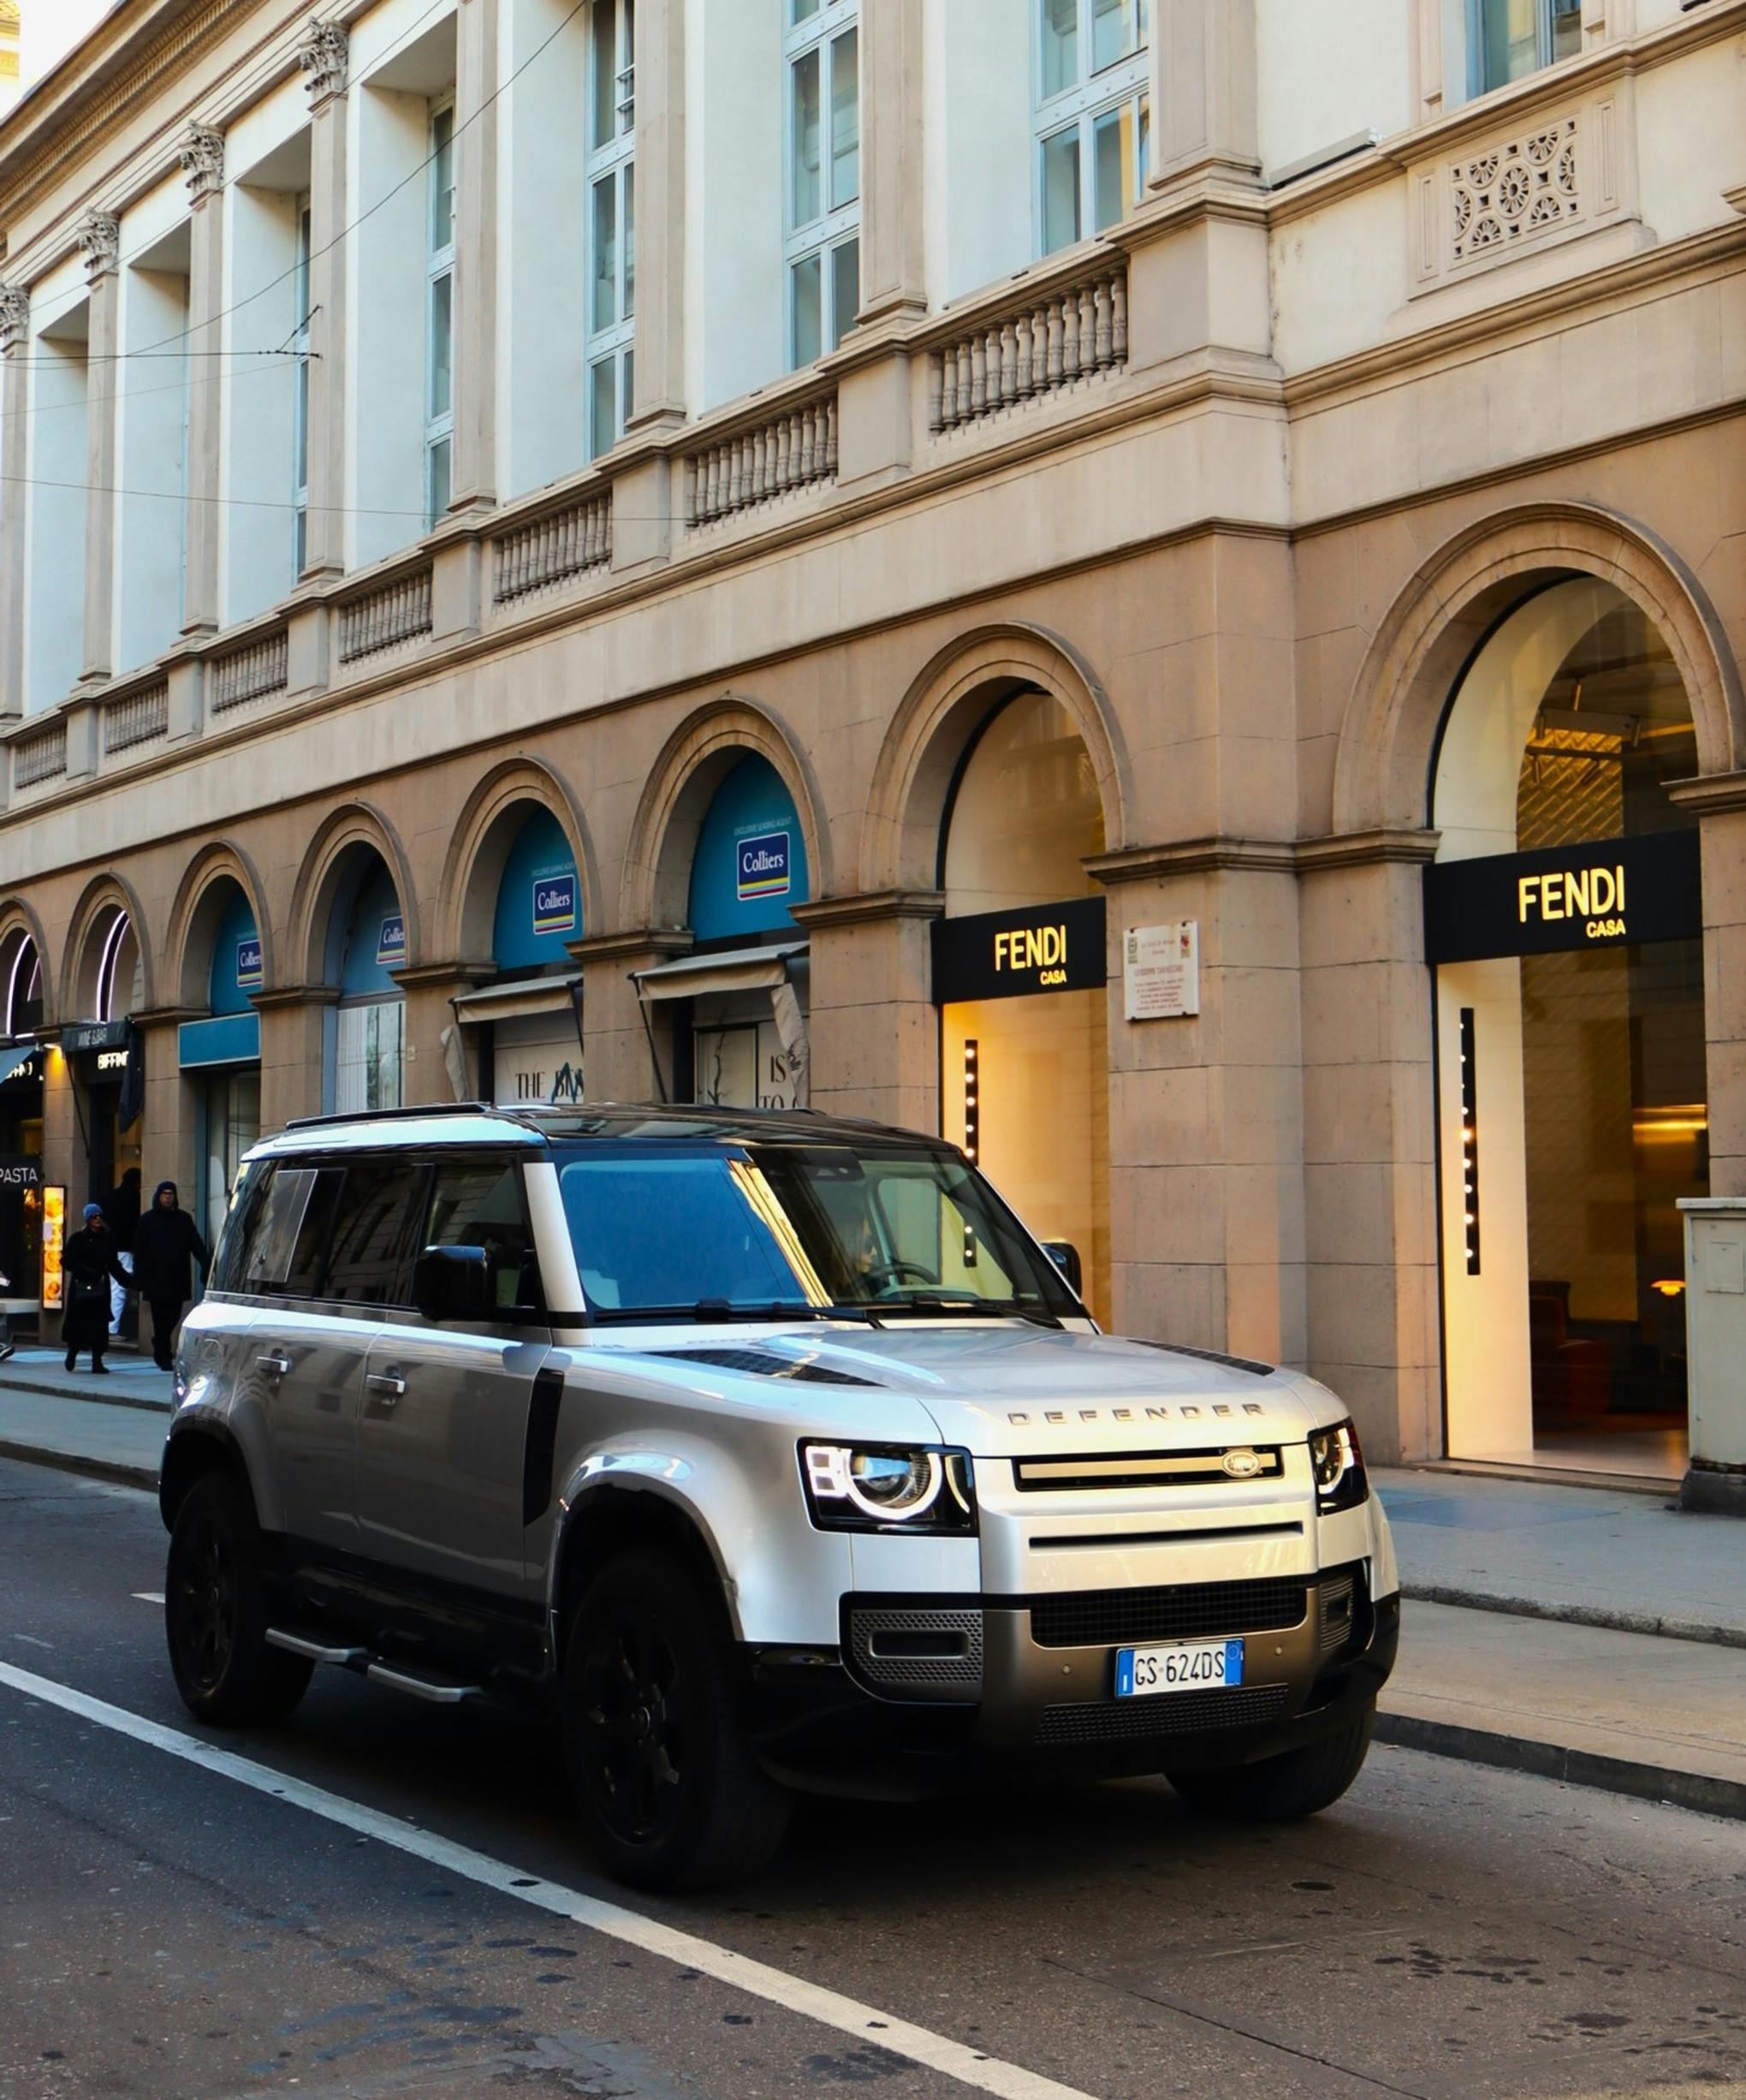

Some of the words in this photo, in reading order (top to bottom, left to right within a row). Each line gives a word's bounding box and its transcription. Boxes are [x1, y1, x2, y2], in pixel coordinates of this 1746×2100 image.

[743, 850, 784, 873] Colliers
[537, 890, 571, 911] Colliers
[1518, 865, 1624, 923] FENDI
[1586, 918, 1626, 938] CASA
[995, 924, 1066, 972] FENDI
[1040, 969, 1067, 985] CASA
[515, 1071, 545, 1099] THE
[1007, 1403, 1267, 1425] DEFENDER
